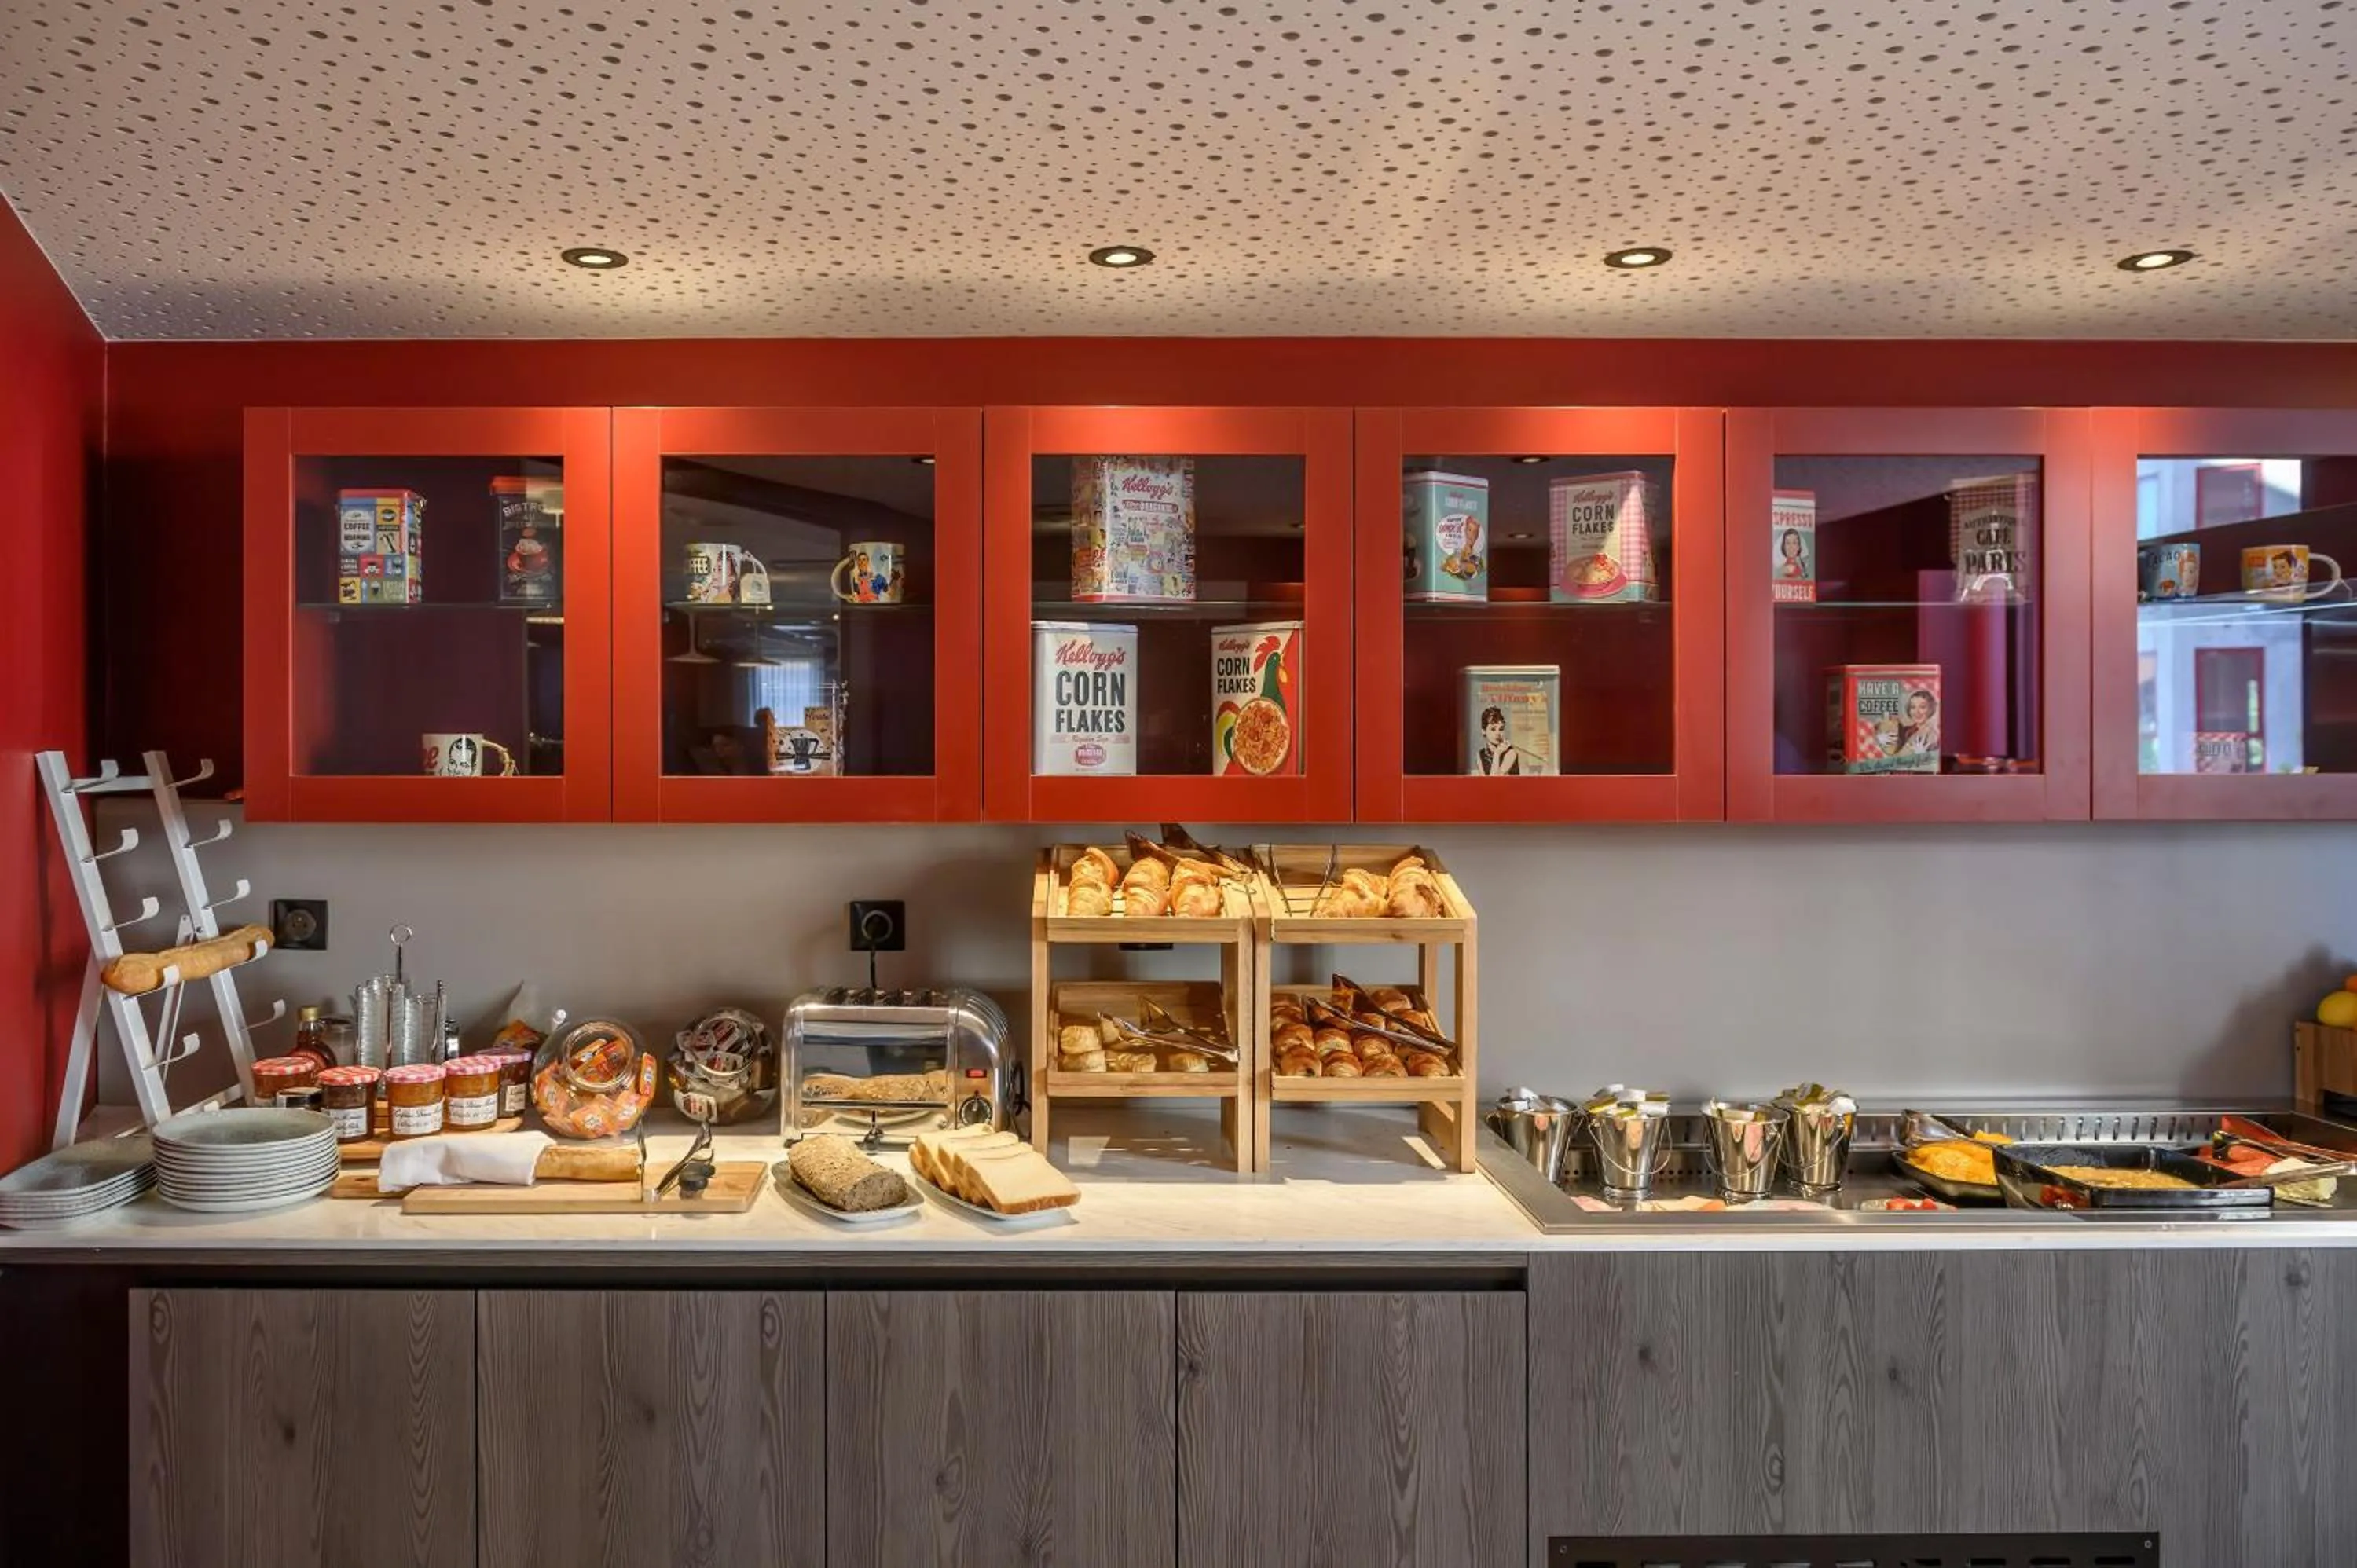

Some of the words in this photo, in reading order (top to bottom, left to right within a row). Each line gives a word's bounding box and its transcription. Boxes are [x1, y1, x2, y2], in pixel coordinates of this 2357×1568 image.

[1121, 474, 1173, 500] Kellogg's
[1572, 504, 1615, 522] CORN
[1772, 511, 1813, 527] SPRESSO
[1572, 521, 1615, 534] FLAKES
[1964, 551, 2027, 574] PARIS
[1055, 639, 1126, 671] Kellogg's
[1217, 657, 1250, 676] CORN
[1055, 670, 1125, 706] CORN
[1217, 676, 1256, 694] FLAKES
[1859, 681, 1887, 696] HAVE
[1893, 682, 1899, 696] A
[1859, 700, 1899, 713] COFFEE
[1055, 709, 1125, 733] FLAKES
